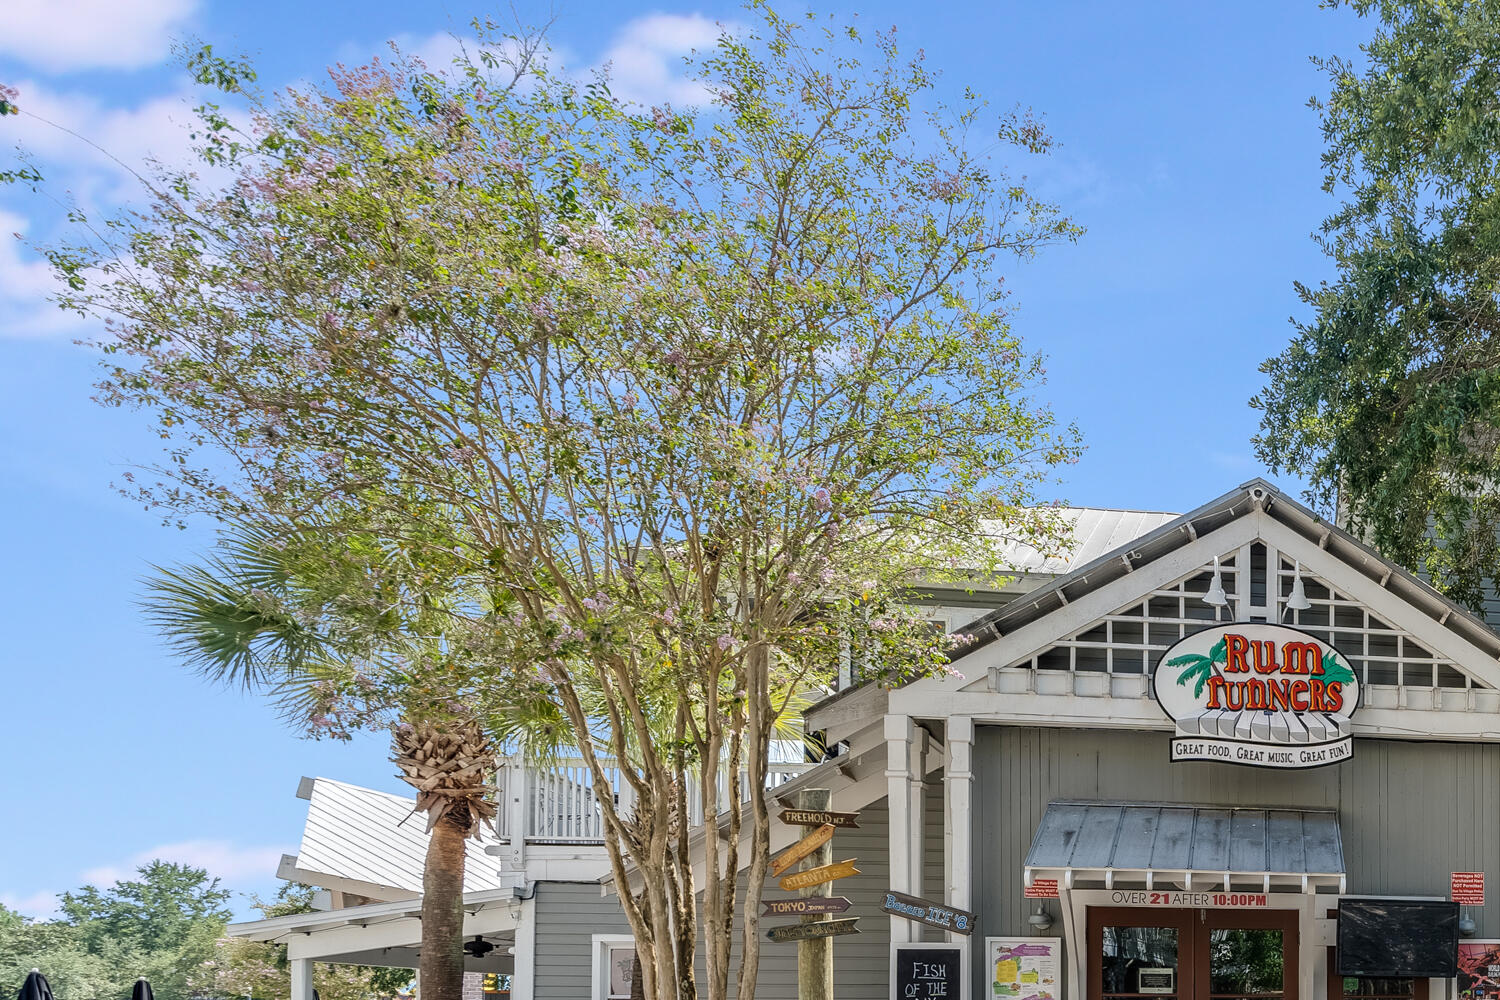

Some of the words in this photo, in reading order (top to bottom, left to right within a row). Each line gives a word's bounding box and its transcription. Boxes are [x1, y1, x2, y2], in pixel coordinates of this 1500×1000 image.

[1223, 633, 1326, 676] Rum
[1207, 745, 1232, 758] FOOD,
[1329, 743, 1350, 758] FUN!
[784, 811, 832, 823] FREEHOLD
[784, 868, 831, 889] ATLANTA
[1111, 891, 1147, 905] OVER
[1149, 892, 1170, 905] 21
[1172, 893, 1209, 906] AFTER
[1211, 894, 1267, 906] 10:00PM
[770, 902, 806, 913] TOKYO
[925, 906, 954, 927] ICE
[913, 961, 947, 979] FISH
[905, 983, 920, 996] OF
[926, 981, 948, 995] THE
